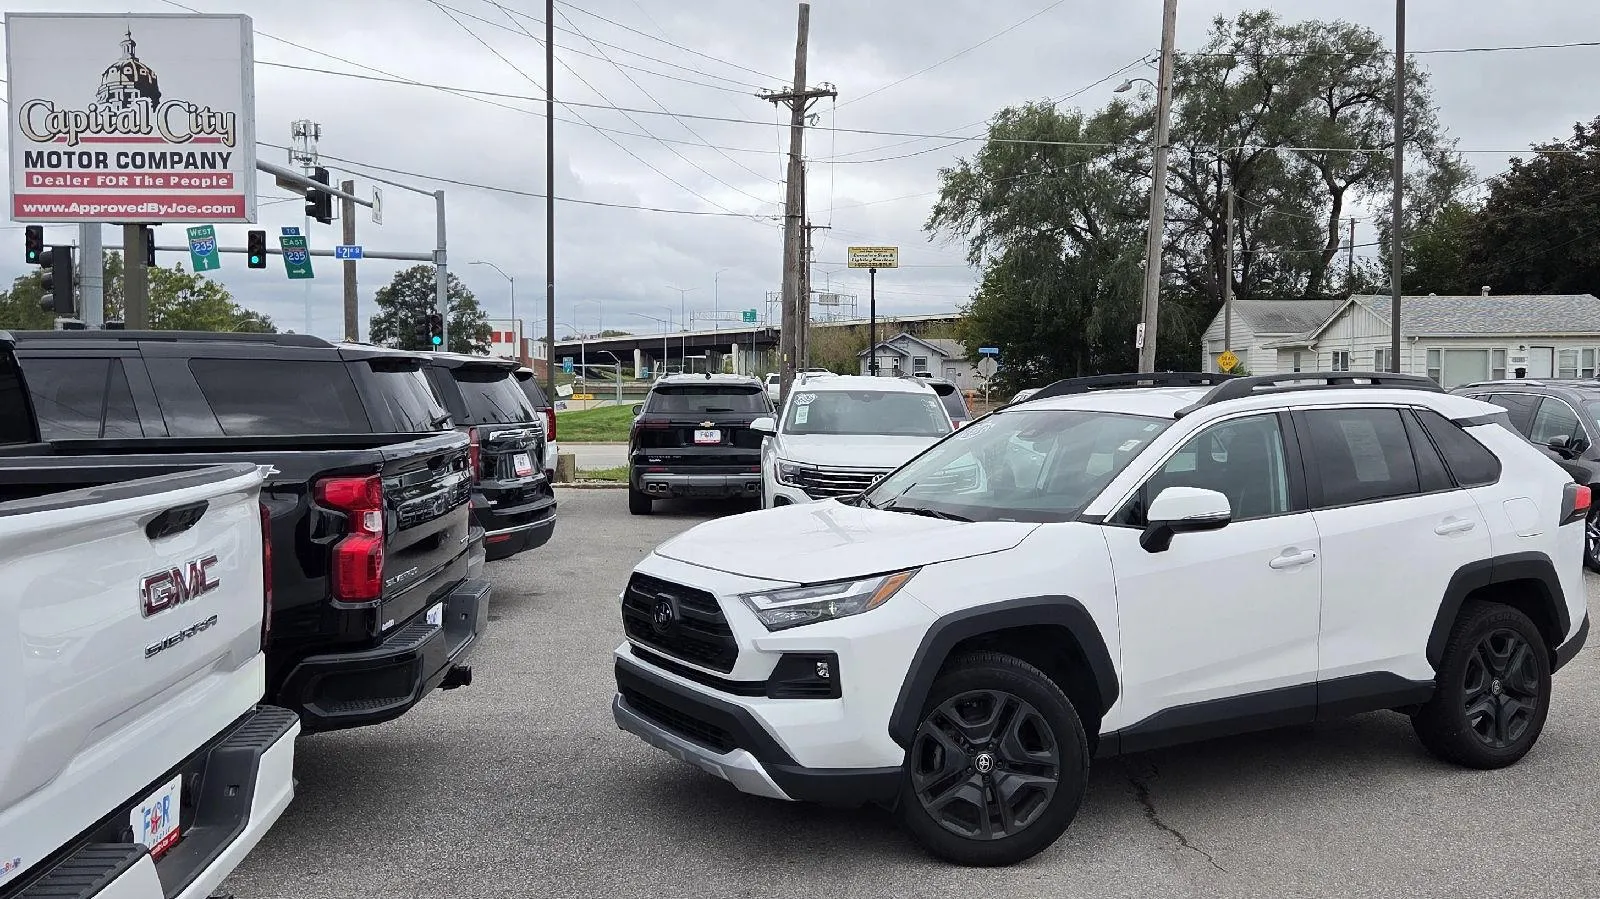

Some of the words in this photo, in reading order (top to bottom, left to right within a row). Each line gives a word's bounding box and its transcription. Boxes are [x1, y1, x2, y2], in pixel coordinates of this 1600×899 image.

[19, 99, 153, 147] Capital
[157, 100, 235, 148] City
[25, 151, 108, 168] MOTOR
[116, 152, 232, 169] COMPANY
[32, 174, 90, 185] Dealer
[97, 176, 129, 186] FOR
[134, 175, 164, 186] The
[170, 176, 228, 187] People
[23, 202, 236, 214] www.ApprovedByJoe.com
[189, 228, 213, 237] WEST
[195, 241, 215, 252] 235
[287, 252, 306, 261] 235
[139, 554, 220, 619] GMC
[144, 614, 218, 659] SIERRA
[143, 794, 170, 842] FOR
